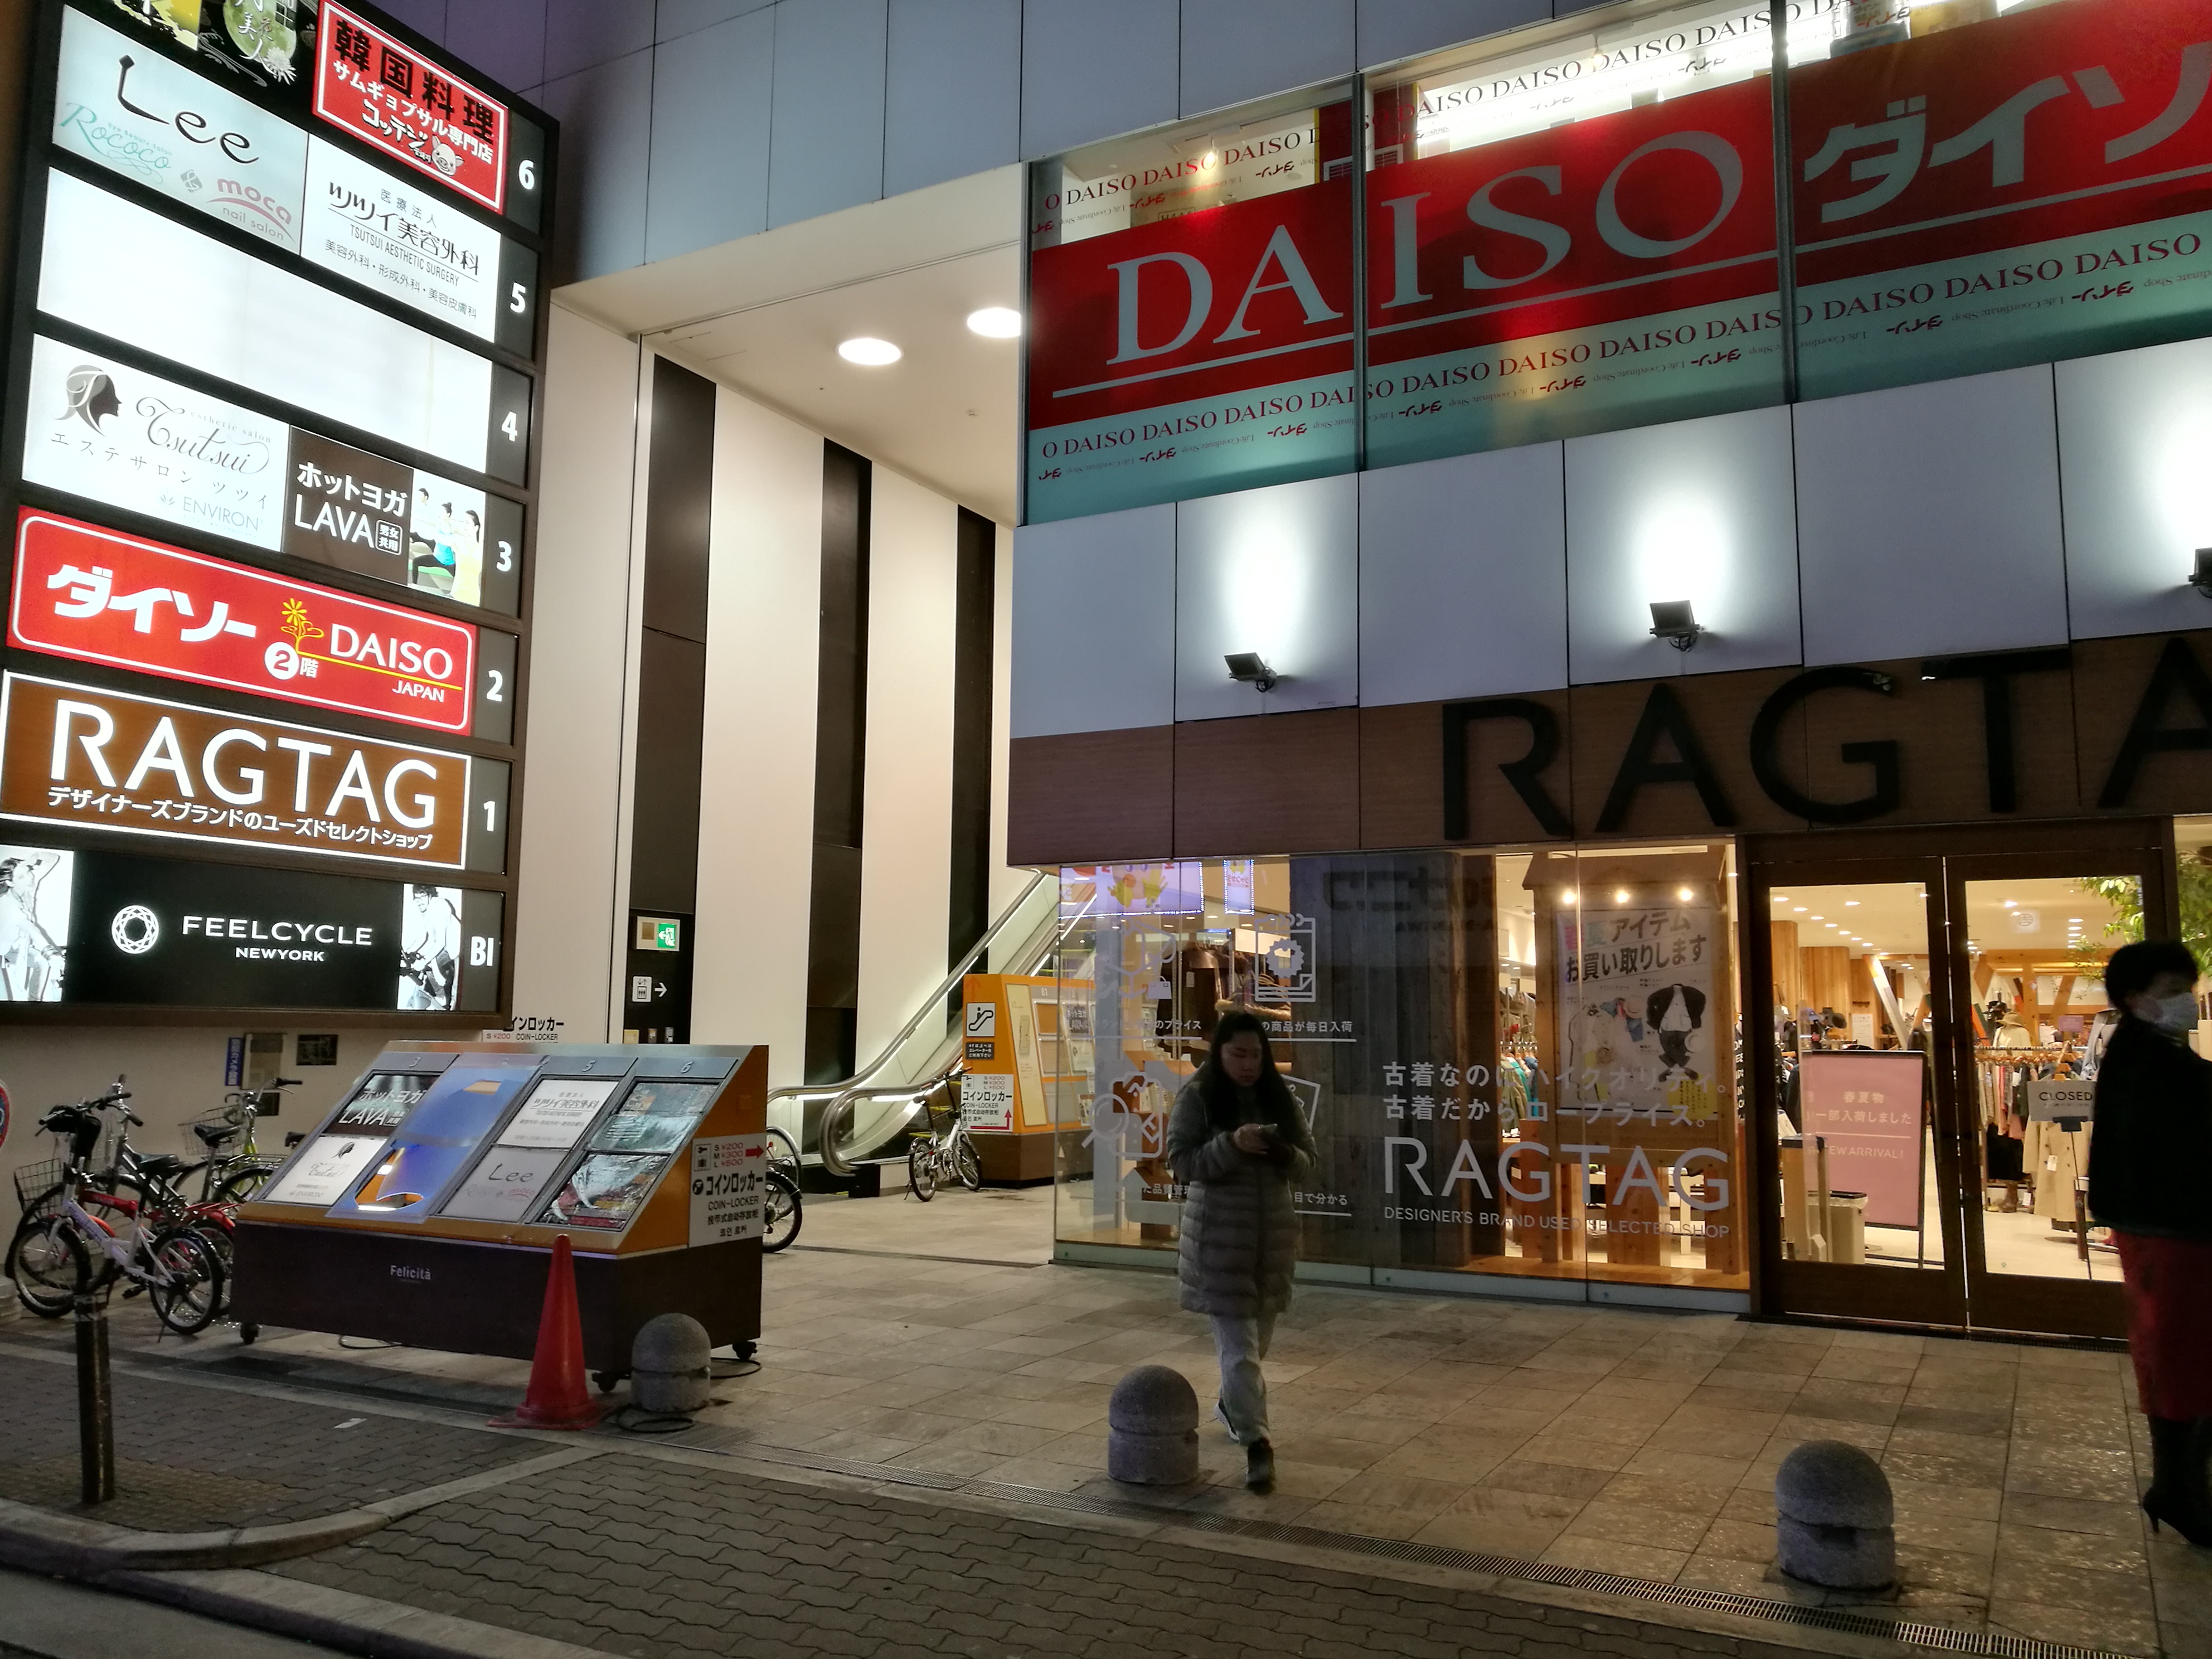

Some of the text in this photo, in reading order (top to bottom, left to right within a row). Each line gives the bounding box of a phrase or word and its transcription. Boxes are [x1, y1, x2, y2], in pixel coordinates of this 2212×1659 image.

[334, 19, 494, 145] 韓国料理
[1492, 60, 1582, 98] DAISO
[1592, 33, 1686, 72] DAISO
[117, 55, 259, 164] Lee
[333, 60, 493, 165] サムギョプサル専門店
[60, 103, 172, 170] Rococo
[518, 159, 535, 190] 6
[1066, 174, 1136, 206] DAISO
[1143, 153, 1216, 186] DAISO
[1224, 133, 1301, 166] DAISO
[217, 178, 292, 225] moca
[381, 188, 437, 228] 医療法人
[222, 206, 283, 240] nail salon
[351, 224, 459, 287] TSUTSUI AESTHETIC SURGERY
[1107, 130, 1743, 365] DAISO
[510, 282, 526, 313] 5
[1063, 428, 1135, 455] DAISO
[1142, 411, 1217, 441] DAISO
[1224, 395, 1303, 425] DAISO
[1402, 362, 1490, 394] DAISO
[1498, 344, 1590, 376] DAISO
[1599, 325, 1696, 358] DAISO
[1823, 283, 1934, 321] DAISO
[1945, 259, 2063, 298] DAISO
[2074, 233, 2200, 275] DAISO
[190, 410, 272, 443] esthetic salon
[501, 411, 518, 442] 4
[297, 462, 407, 517] ホットヨガ
[183, 496, 259, 531] ENVIRON
[294, 493, 375, 549] LAVA
[496, 540, 512, 572] 3
[47, 564, 256, 642] ダイソー
[330, 623, 454, 680] DAISO
[392, 680, 445, 704] JAPAN
[486, 670, 503, 702] 2
[51, 699, 437, 829] RAGTAG
[47, 786, 433, 851] デザイナーズブランドのユーズドセレクトショップ
[483, 801, 495, 831] 1
[183, 915, 372, 947] FEELCYCLE
[1566, 935, 1706, 983] お買い取りします
[582, 1060, 596, 1072] 5
[680, 1061, 694, 1073] 6
[359, 1089, 427, 1104] ホットヨガ
[963, 1092, 1012, 1101] コインロッカー
[1382, 1095, 1705, 1128] 古着だからロープライス。
[1844, 1091, 1884, 1103] 春夏物
[2039, 1092, 2092, 1101] CLOSED
[338, 1107, 389, 1126] LAVA
[1816, 1110, 1912, 1124] 一部入荷しました
[489, 1163, 533, 1182] Lee
[722, 1158, 743, 1167] ¥500
[1384, 1136, 1729, 1211] RAGTAG
[706, 1171, 763, 1195] コインロッカー
[708, 1196, 759, 1210] COIN-LOCKER
[1384, 1206, 1473, 1225] DESIGNER'S
[1479, 1212, 1534, 1229] BRAND
[1540, 1216, 1583, 1231] USED
[1683, 1224, 1729, 1239] SHOP
